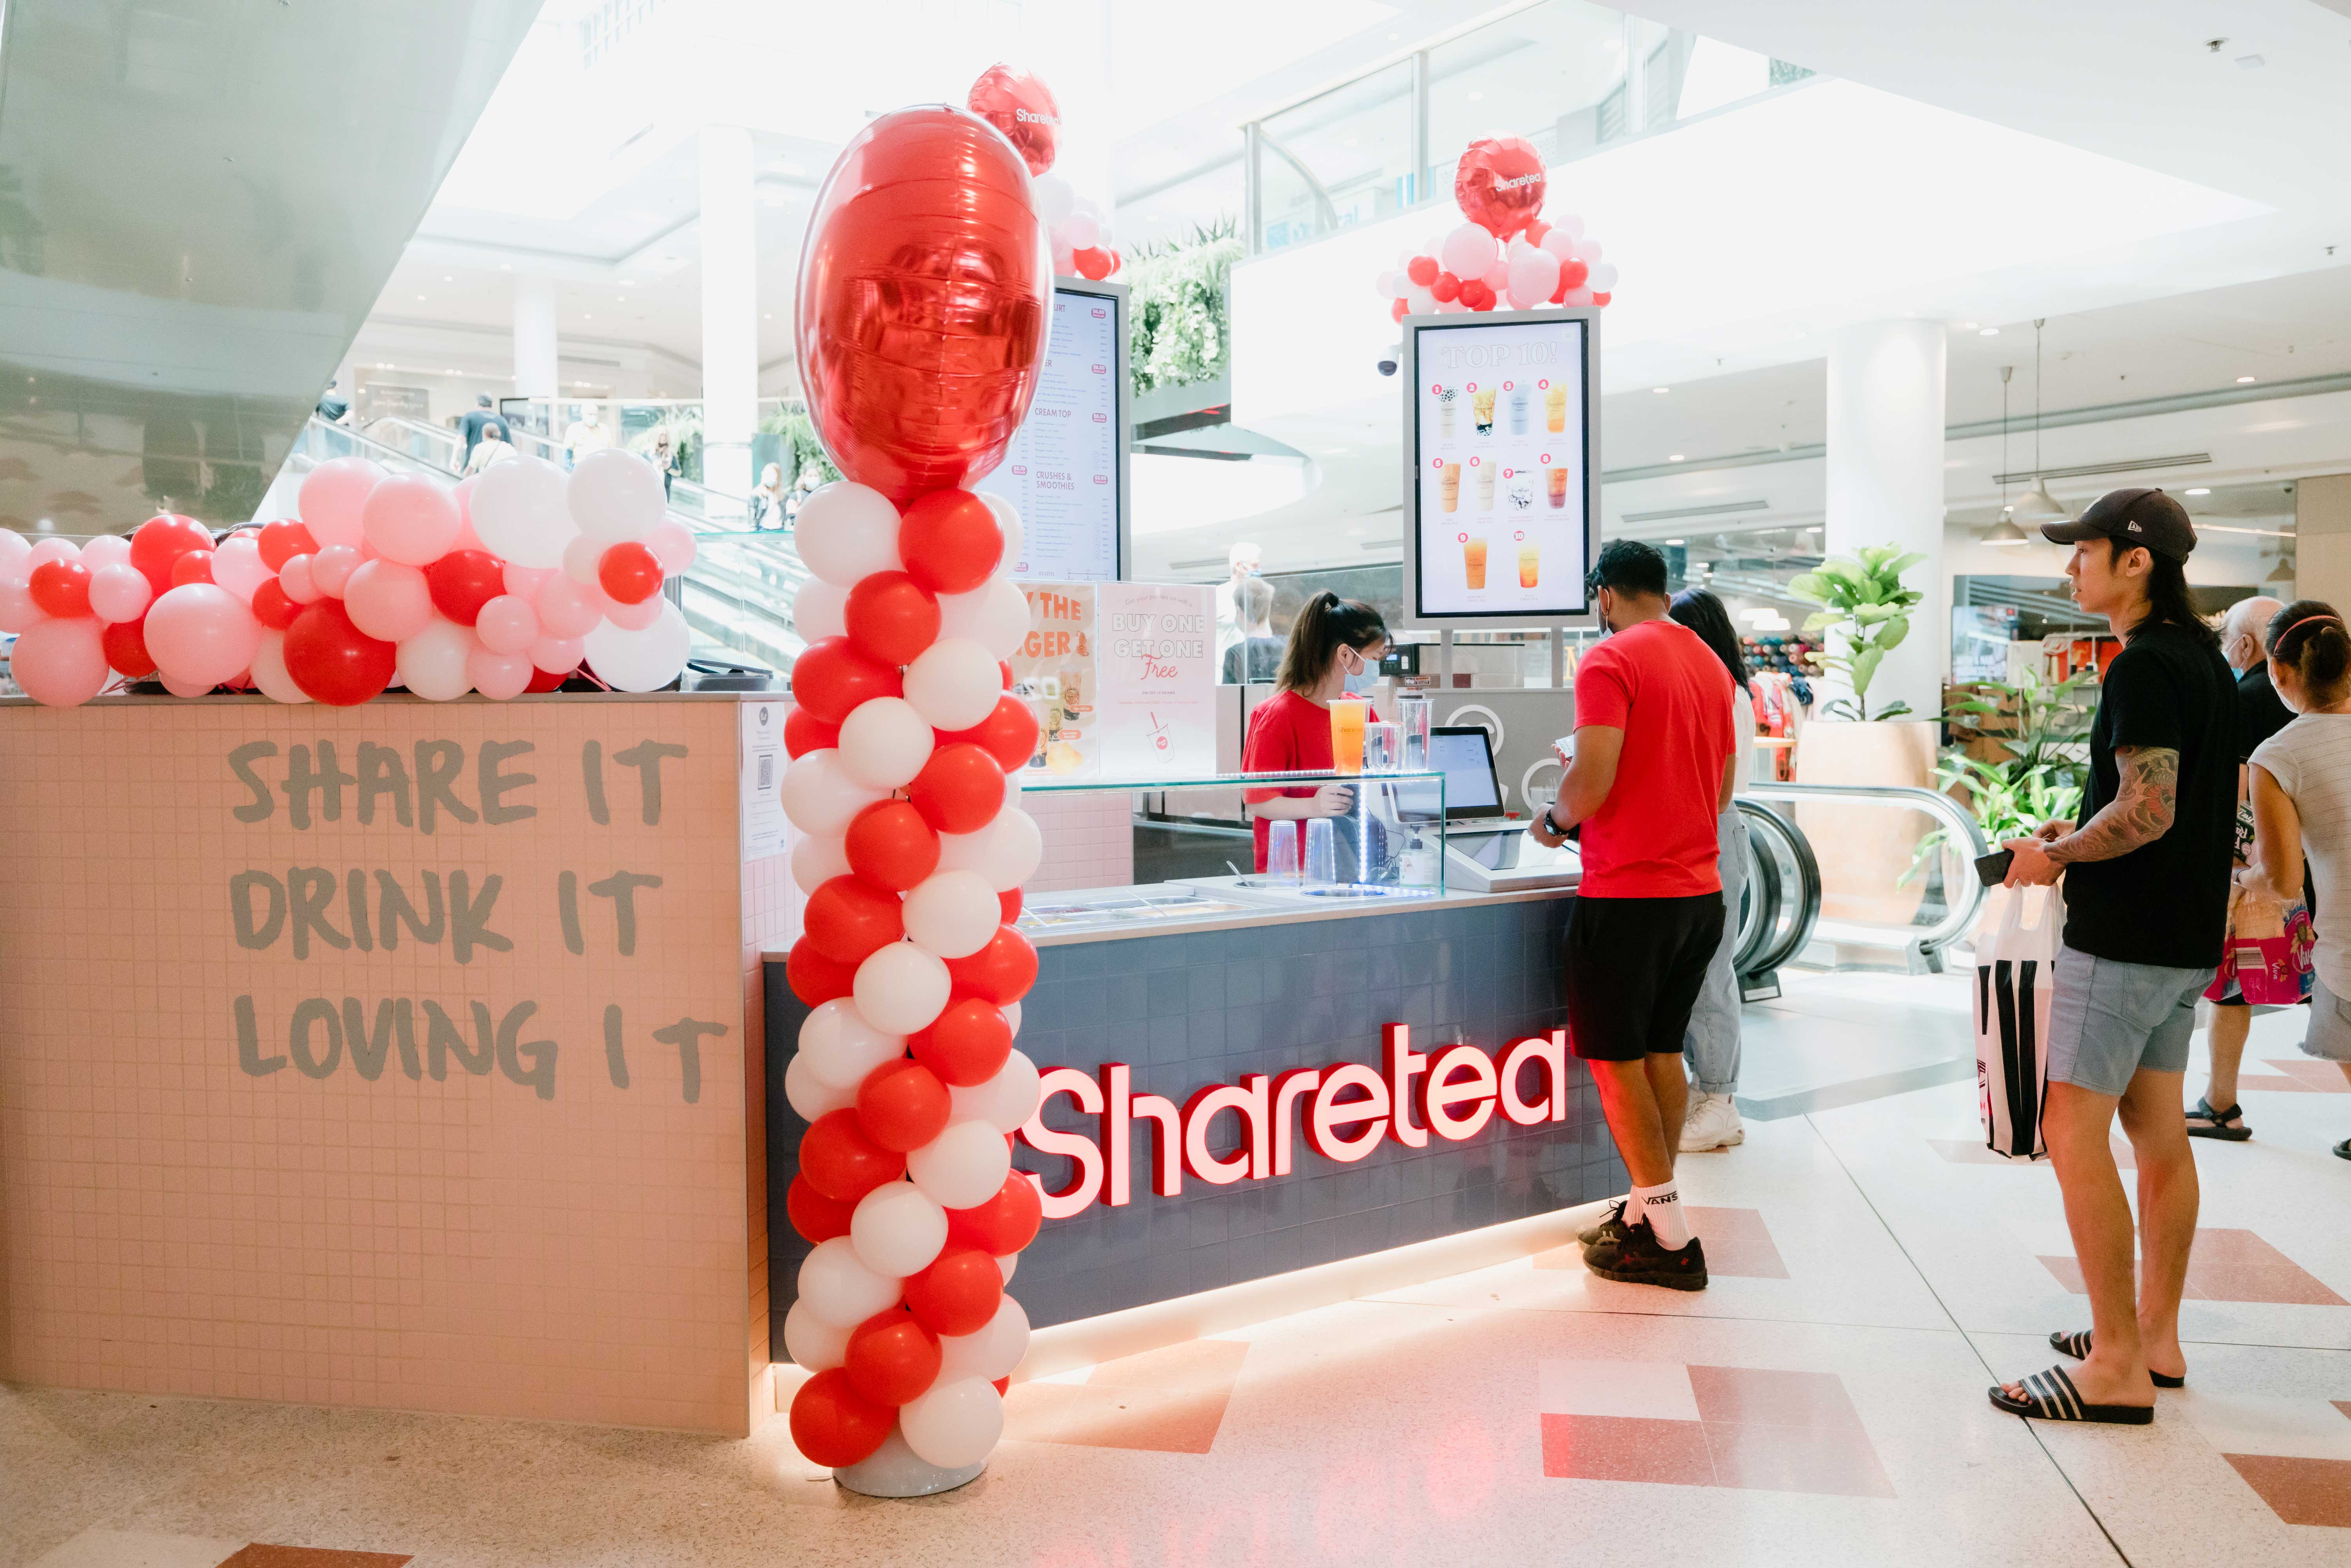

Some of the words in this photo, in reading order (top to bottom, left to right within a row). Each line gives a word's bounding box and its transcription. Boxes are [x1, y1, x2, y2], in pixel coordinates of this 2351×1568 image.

[1016, 108, 1059, 126] Sharetea
[1442, 345, 1511, 368] TOP
[1517, 342, 1557, 365] 10!
[1035, 407, 1057, 417] CREAM
[1059, 409, 1072, 418] TOP
[1036, 471, 1065, 480] CRUSHES
[1036, 480, 1075, 491] SMOOTHIES
[1040, 592, 1082, 621] THE
[1112, 614, 1156, 632] BUY
[1161, 614, 1205, 633] ONE
[1114, 639, 1154, 657] GET
[1159, 639, 1203, 658] ONE
[1141, 654, 1179, 680] Free
[228, 739, 538, 835] SHARE
[582, 739, 688, 826] IT
[230, 867, 514, 964] DRINK
[558, 870, 663, 956] IT
[234, 995, 558, 1100] LOVING
[603, 1004, 728, 1104] IT
[1019, 1022, 1566, 1219] Sharetea
[1641, 1190, 1678, 1206] VANS
